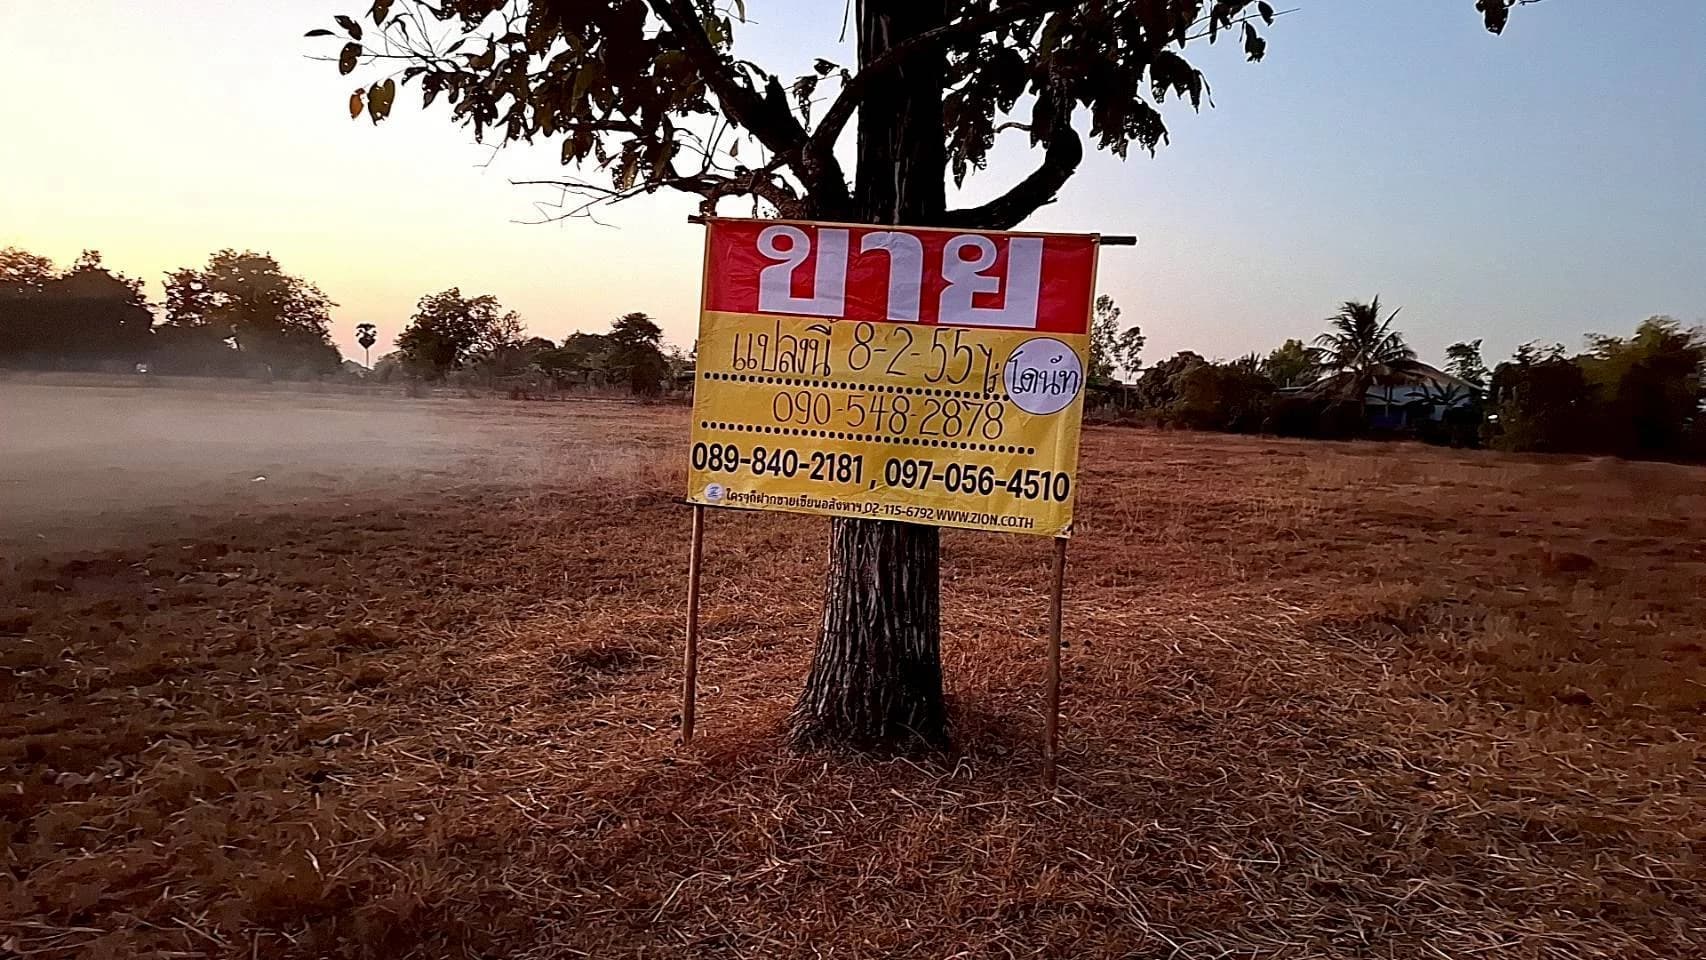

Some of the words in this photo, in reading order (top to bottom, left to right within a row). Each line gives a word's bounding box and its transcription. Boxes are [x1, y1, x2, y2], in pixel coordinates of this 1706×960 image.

[756, 224, 1043, 328] ขาย
[773, 390, 1004, 440] 090-548-2878
[691, 442, 864, 484] 089-840-2181
[885, 458, 1070, 502] 097-056-4510
[936, 508, 1034, 529] WWW.ZION.CO.TH
